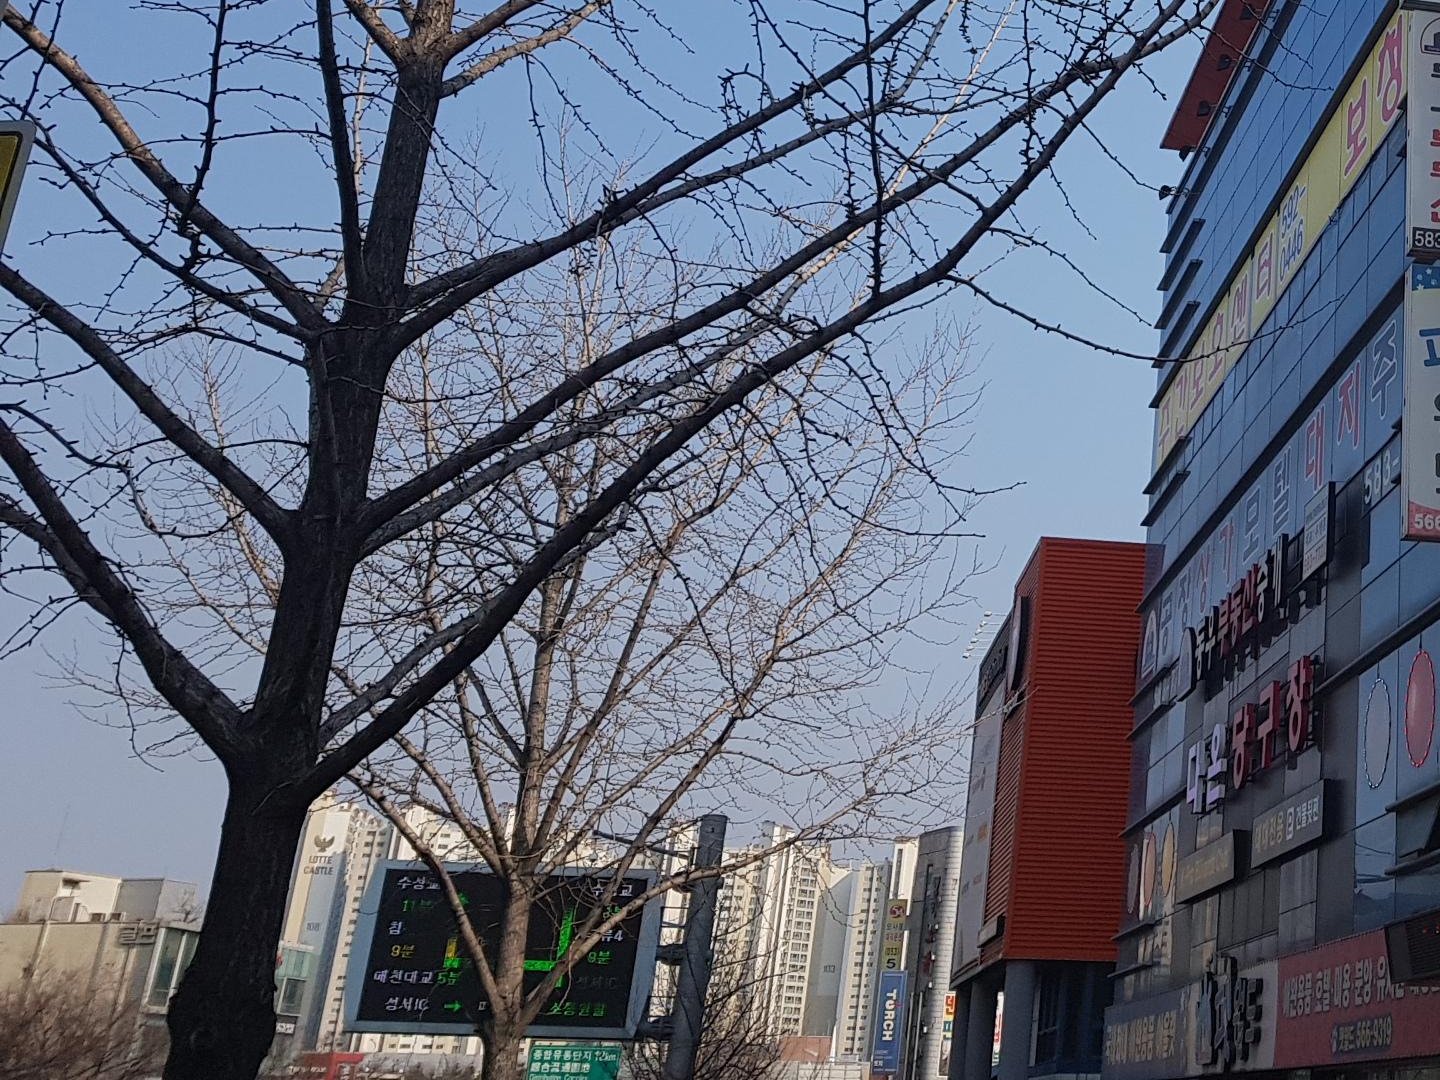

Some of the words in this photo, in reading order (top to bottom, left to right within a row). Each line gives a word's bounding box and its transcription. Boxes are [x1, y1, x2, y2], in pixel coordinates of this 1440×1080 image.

[309, 855, 333, 864] LOTTE
[303, 865, 334, 876] CASTLE
[881, 989, 898, 1041] TORCH
